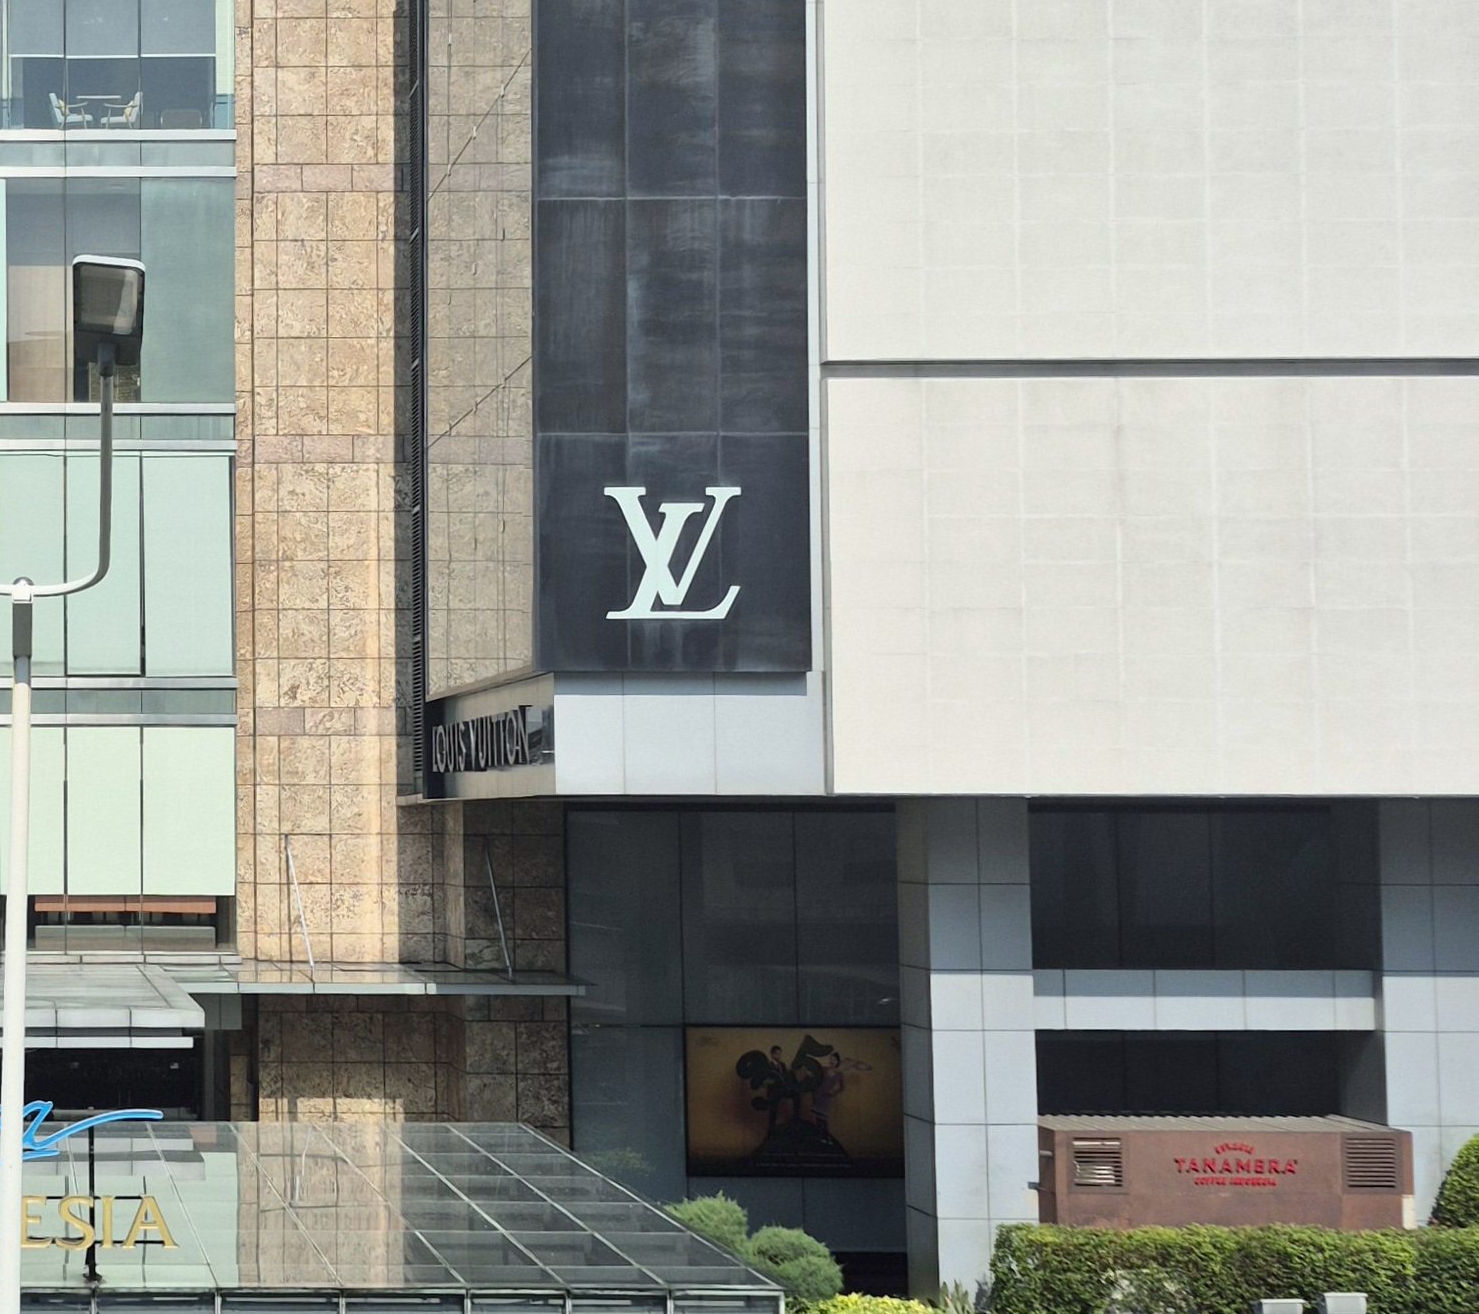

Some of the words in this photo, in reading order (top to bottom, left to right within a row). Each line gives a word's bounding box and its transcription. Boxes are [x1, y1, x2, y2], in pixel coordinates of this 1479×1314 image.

[432, 721, 466, 773] LOUIS
[469, 704, 533, 771] VUITTON
[1174, 1157, 1296, 1174] TANAMERA
